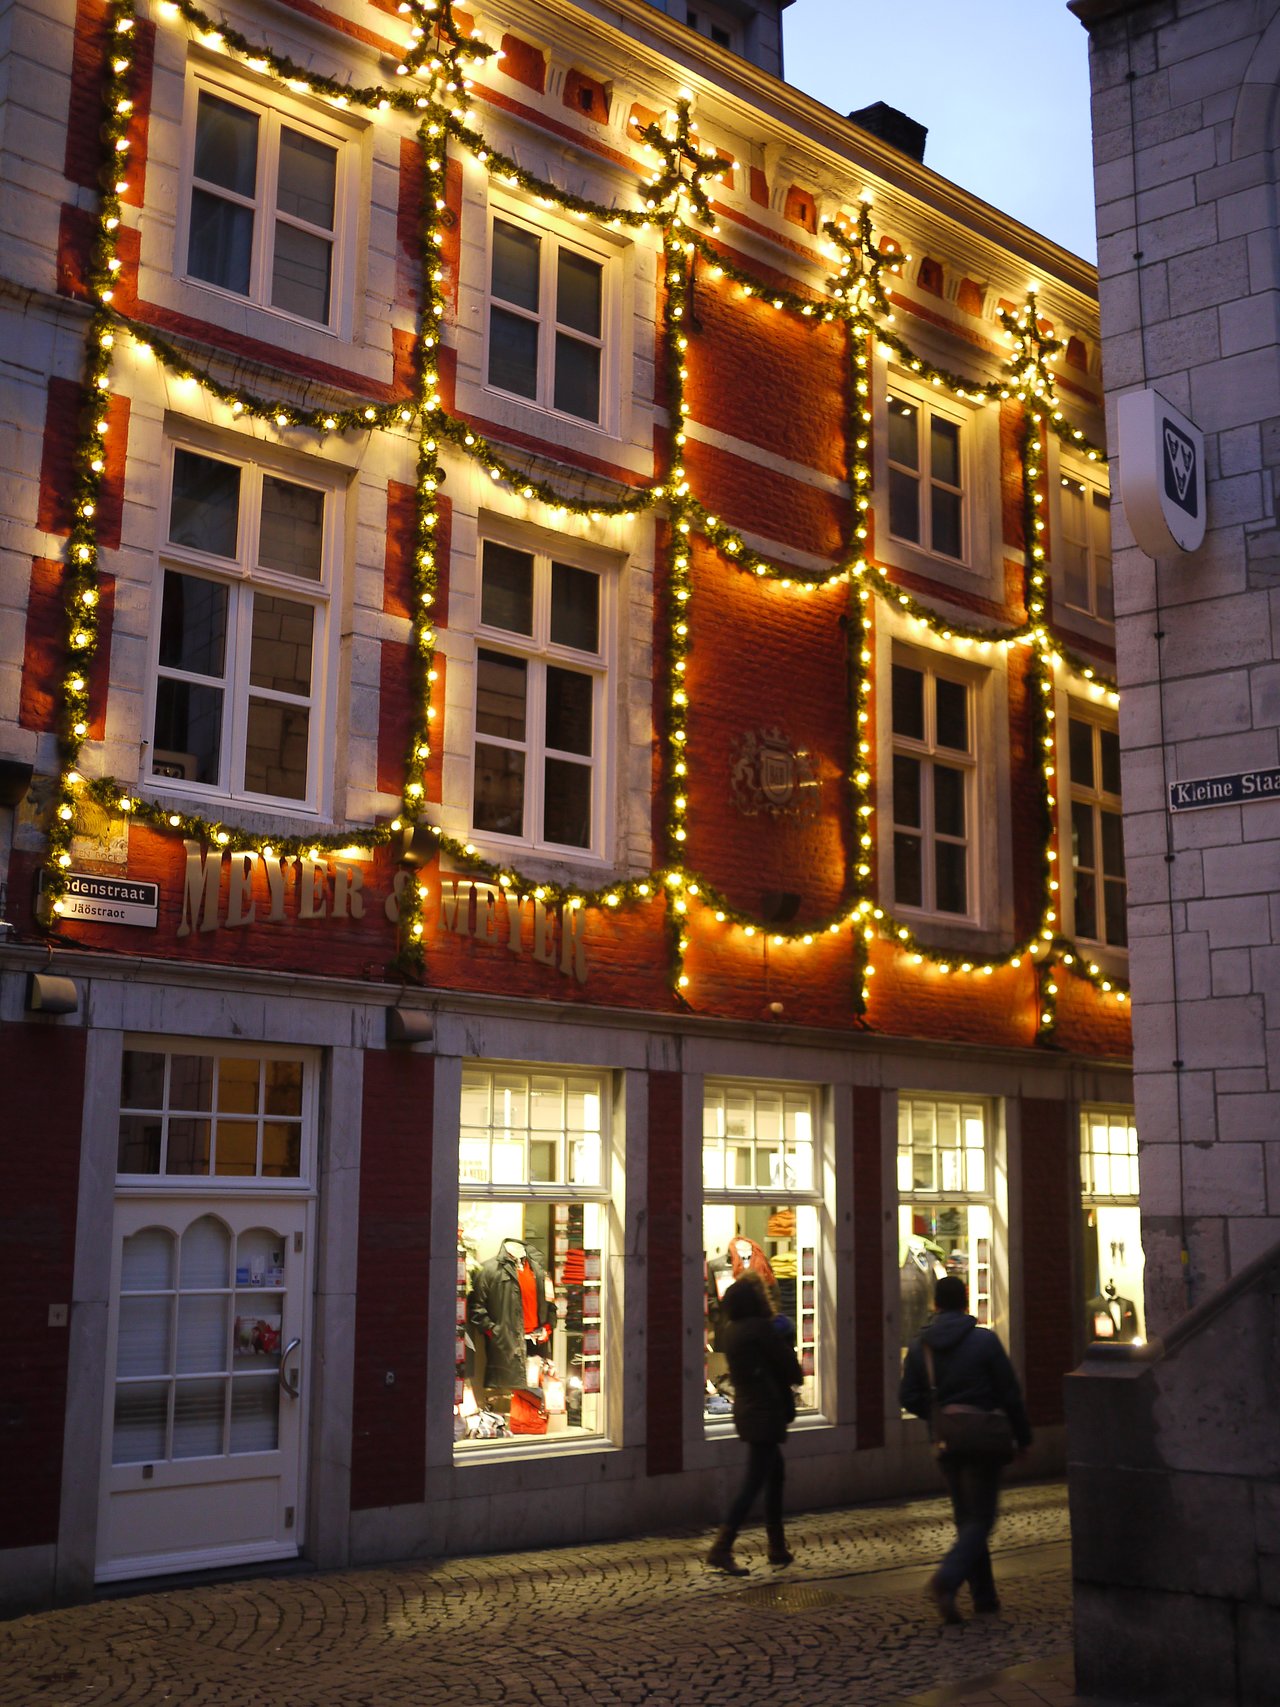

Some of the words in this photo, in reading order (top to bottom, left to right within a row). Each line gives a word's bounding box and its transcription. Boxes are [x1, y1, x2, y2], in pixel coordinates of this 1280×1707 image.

[1177, 782, 1233, 803] Kleine
[64, 879, 145, 900] odenstraat
[71, 903, 125, 919] Jäöstraot
[176, 839, 366, 937] MEYER
[437, 880, 589, 984] MEYER
